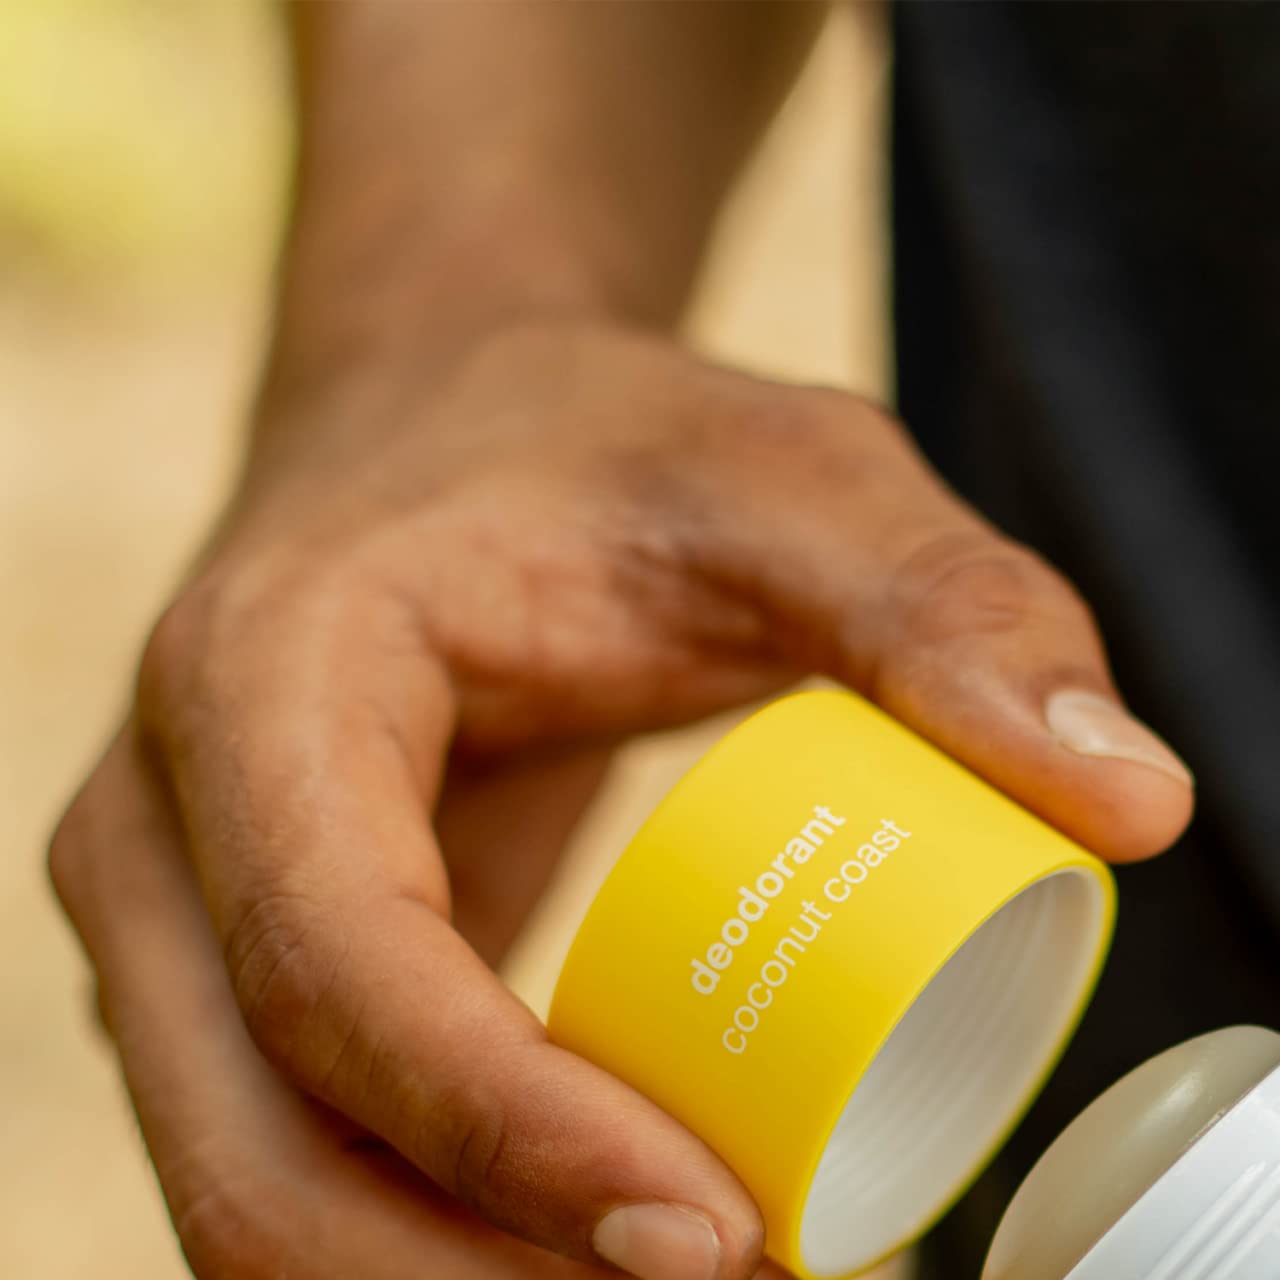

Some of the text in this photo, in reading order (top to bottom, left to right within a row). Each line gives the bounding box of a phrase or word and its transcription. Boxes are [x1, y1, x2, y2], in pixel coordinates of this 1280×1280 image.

[690, 805, 846, 995] deodorant
[722, 818, 912, 1053] coconut coast
